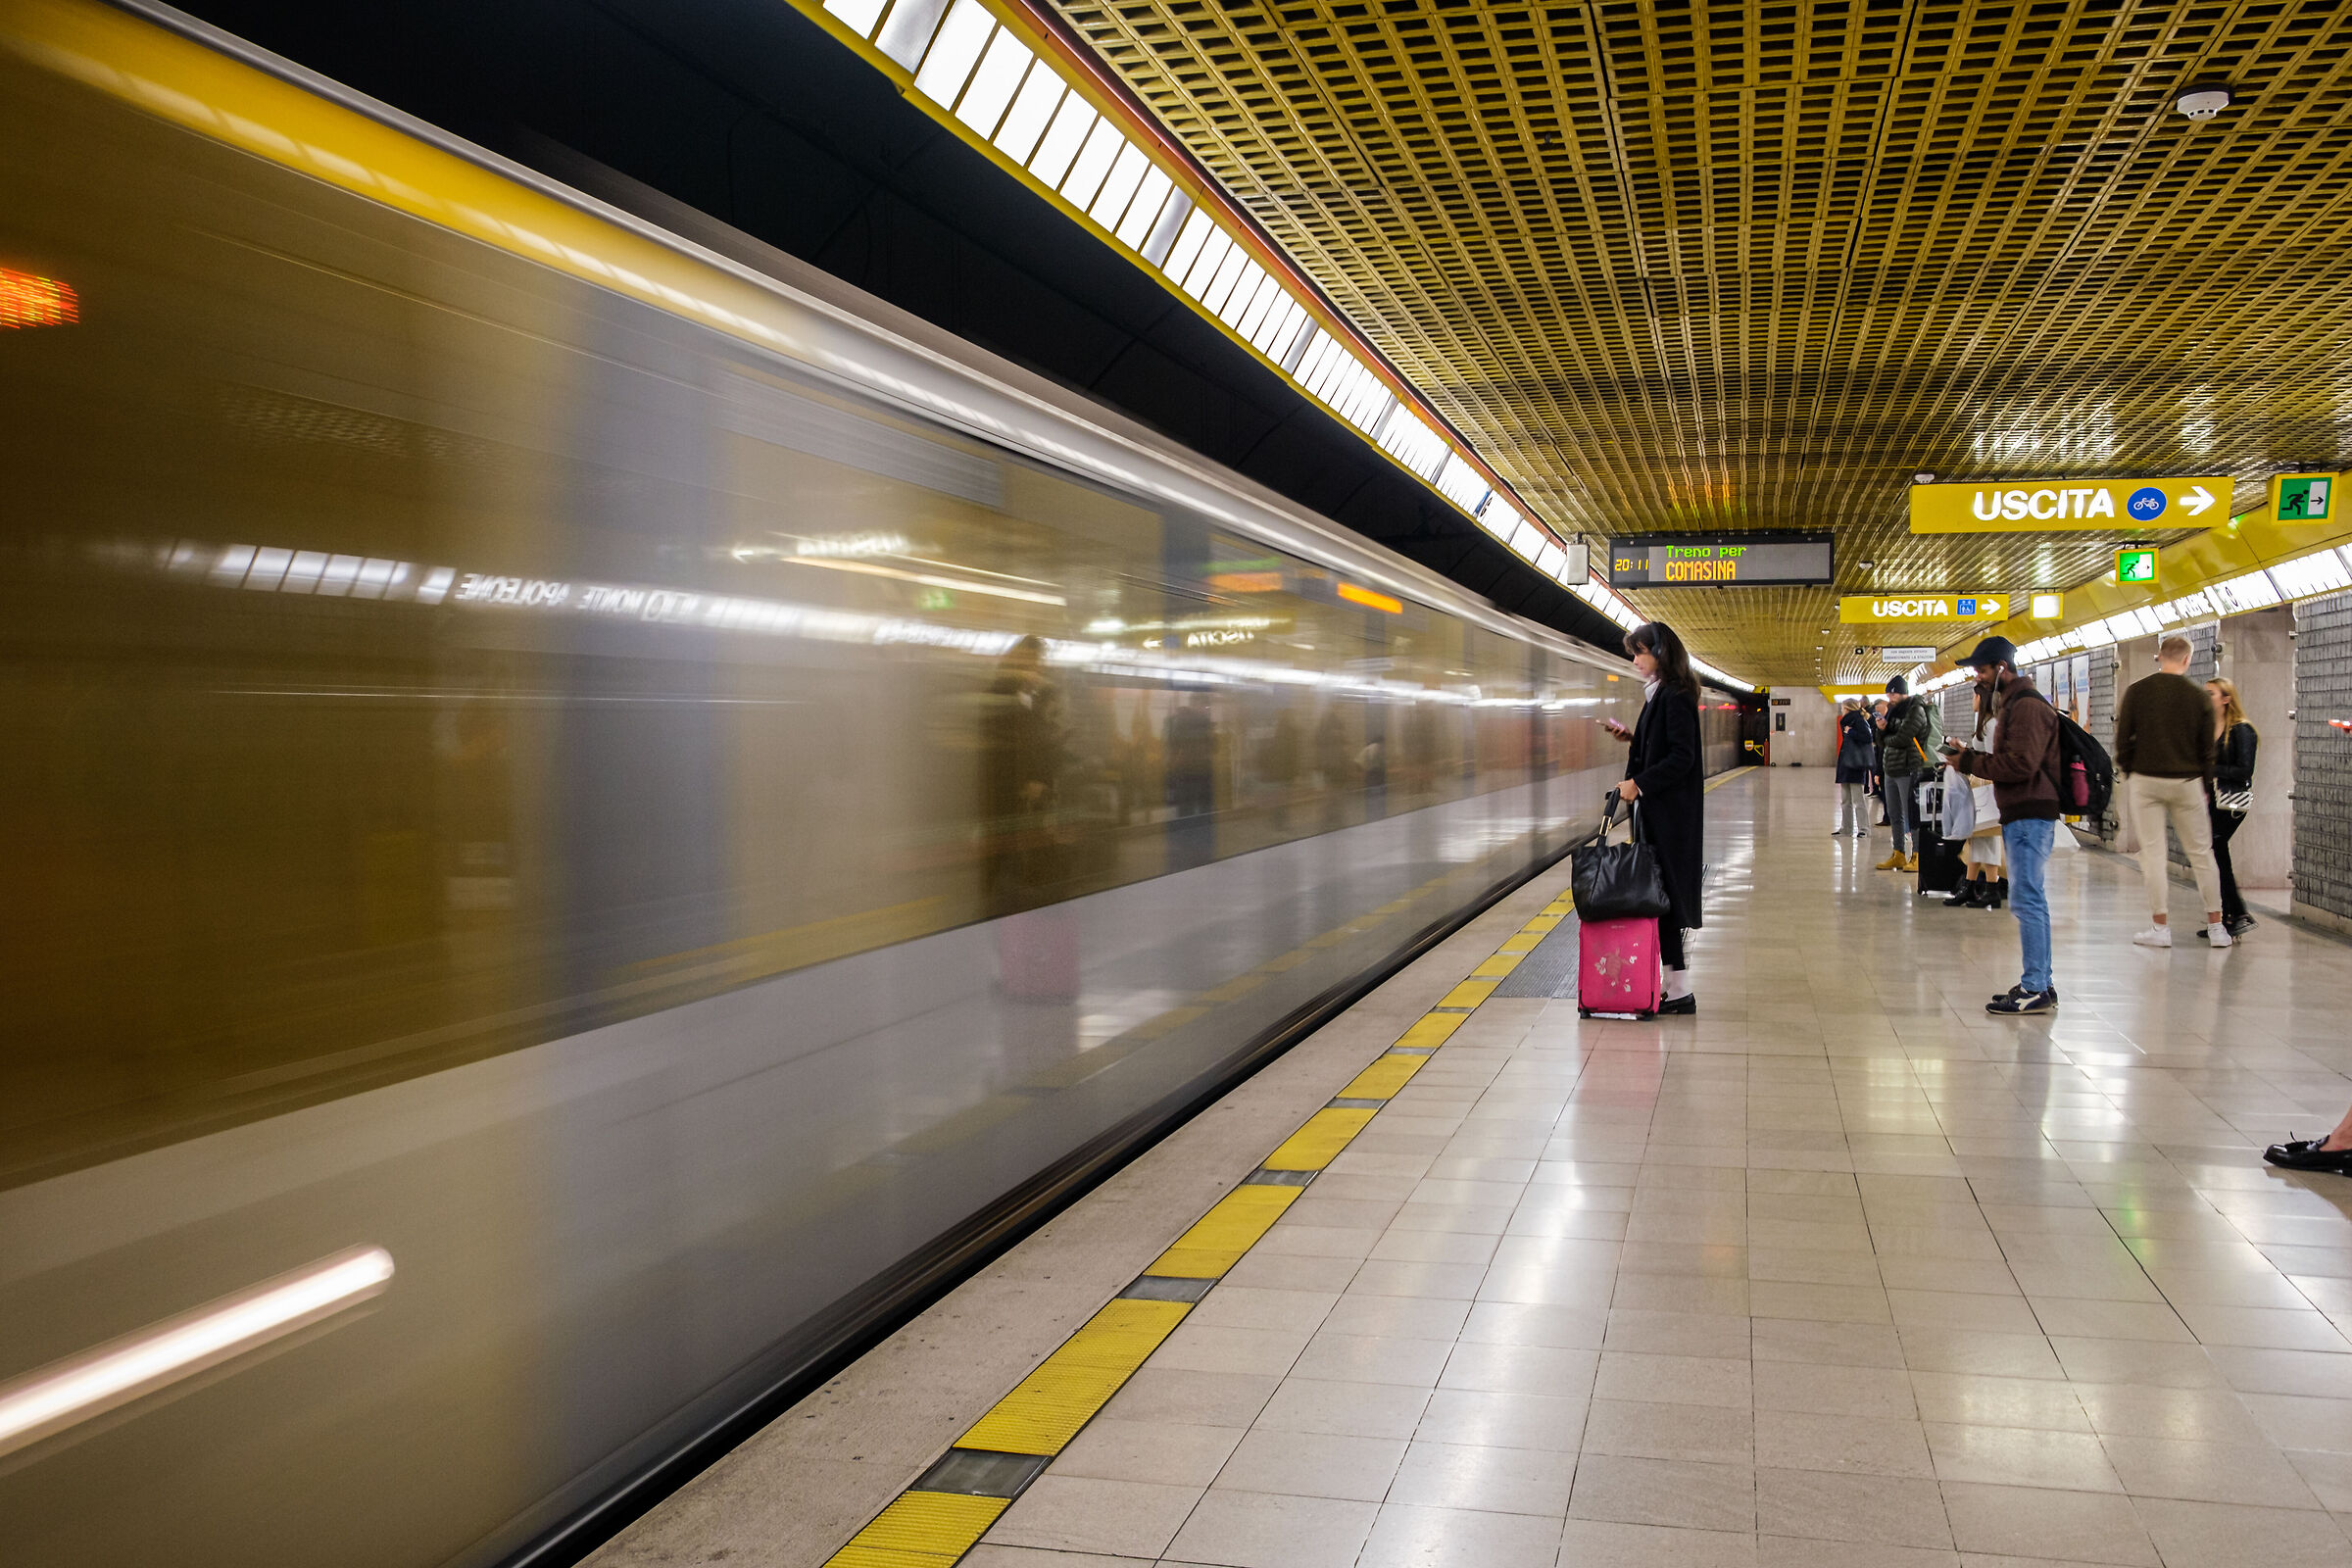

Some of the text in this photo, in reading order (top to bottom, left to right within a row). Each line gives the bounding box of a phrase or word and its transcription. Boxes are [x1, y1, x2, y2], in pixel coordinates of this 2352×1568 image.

[1973, 488, 2115, 521] USCITA
[1666, 545, 1747, 559] Treno per
[1614, 559, 1649, 571] 20:11
[1666, 560, 1736, 581] COMASINA
[1873, 600, 1948, 617] USCITA
